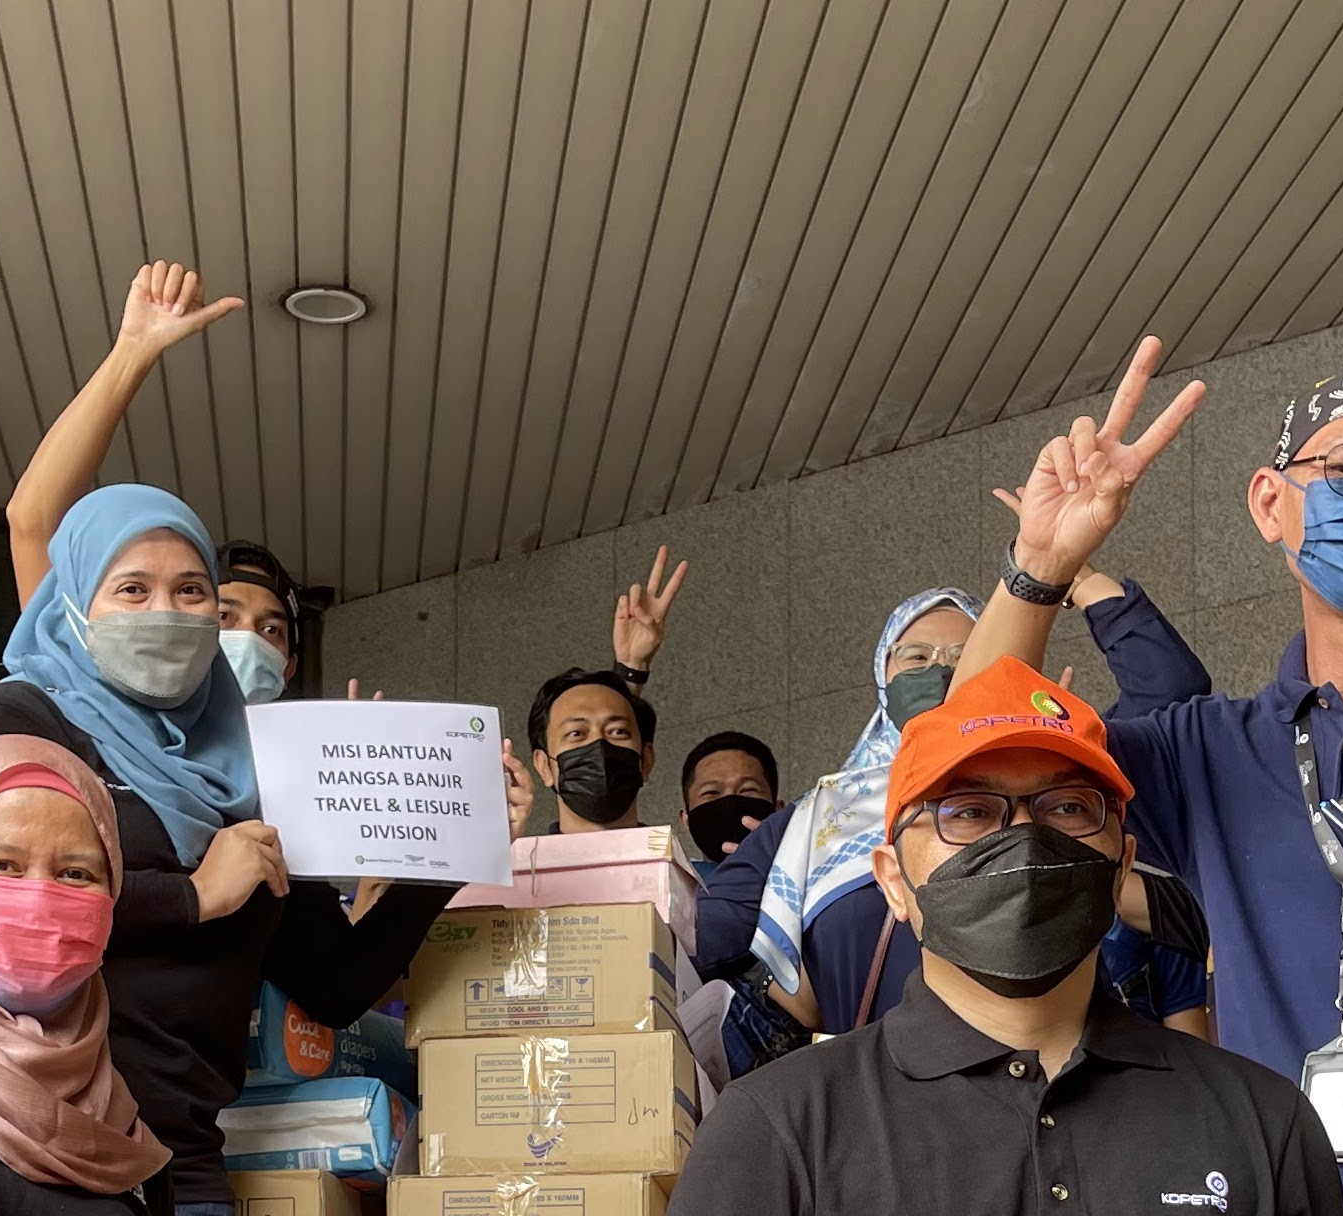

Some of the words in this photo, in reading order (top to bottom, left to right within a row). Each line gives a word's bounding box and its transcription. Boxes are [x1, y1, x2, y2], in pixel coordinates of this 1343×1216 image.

[960, 715, 1074, 738] KOPETRO
[321, 744, 361, 760] MISI
[367, 745, 452, 762] BANTUAN
[318, 770, 399, 786] MANGSA
[403, 772, 463, 789] BANJIR
[314, 797, 383, 813] TRAVEL
[387, 798, 401, 813] &
[406, 799, 471, 817] LEISURE
[360, 824, 437, 841] DIVISION
[563, 917, 579, 925] Sdn
[582, 916, 599, 925] Bhd
[341, 1037, 377, 1062] diapers
[481, 1076, 494, 1084] NET
[481, 1094, 504, 1102] GROSS
[481, 1112, 507, 1120] CARTON
[448, 1196, 491, 1204] DIMENSIONS
[1161, 1192, 1228, 1214] KOPETRO
